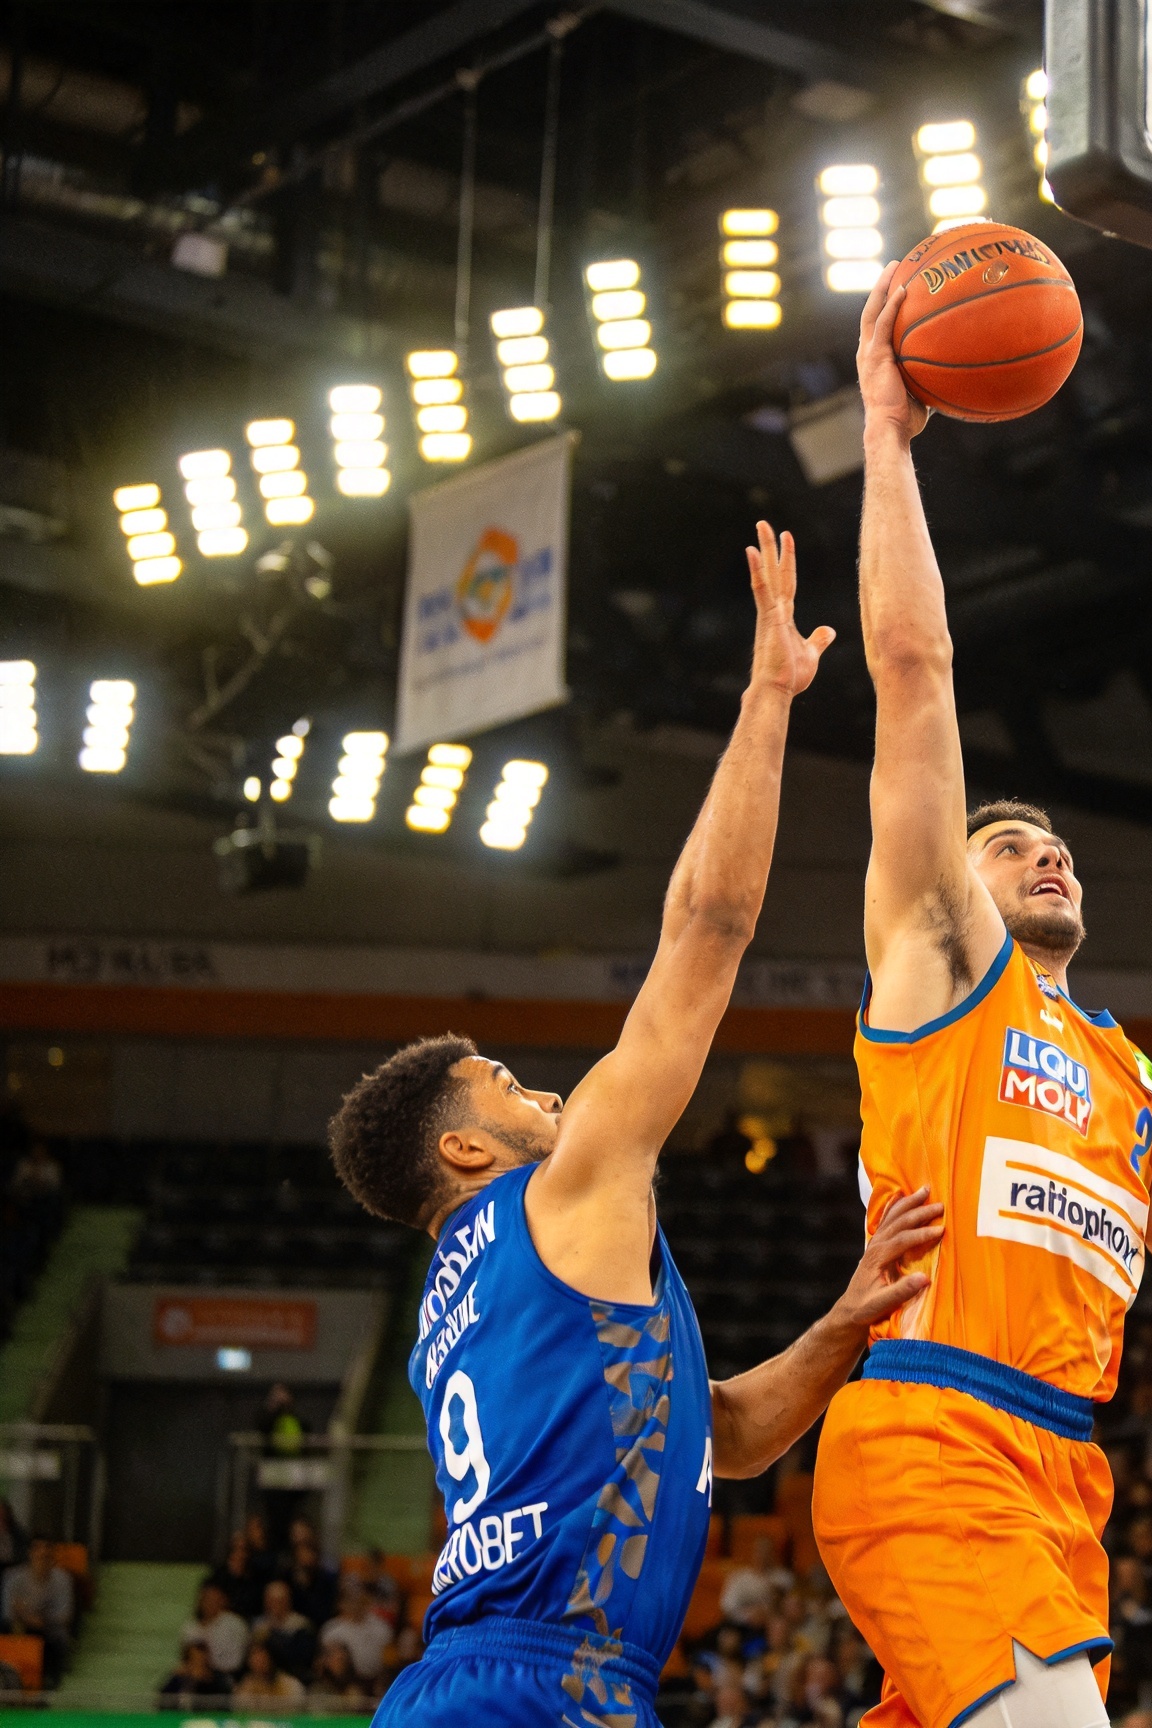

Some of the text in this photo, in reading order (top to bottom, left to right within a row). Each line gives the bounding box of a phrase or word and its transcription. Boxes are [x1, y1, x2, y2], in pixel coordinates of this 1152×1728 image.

[1009, 1032, 1088, 1093] LIQU
[1004, 1069, 1092, 1129] MOLY
[438, 1369, 490, 1524] 9
